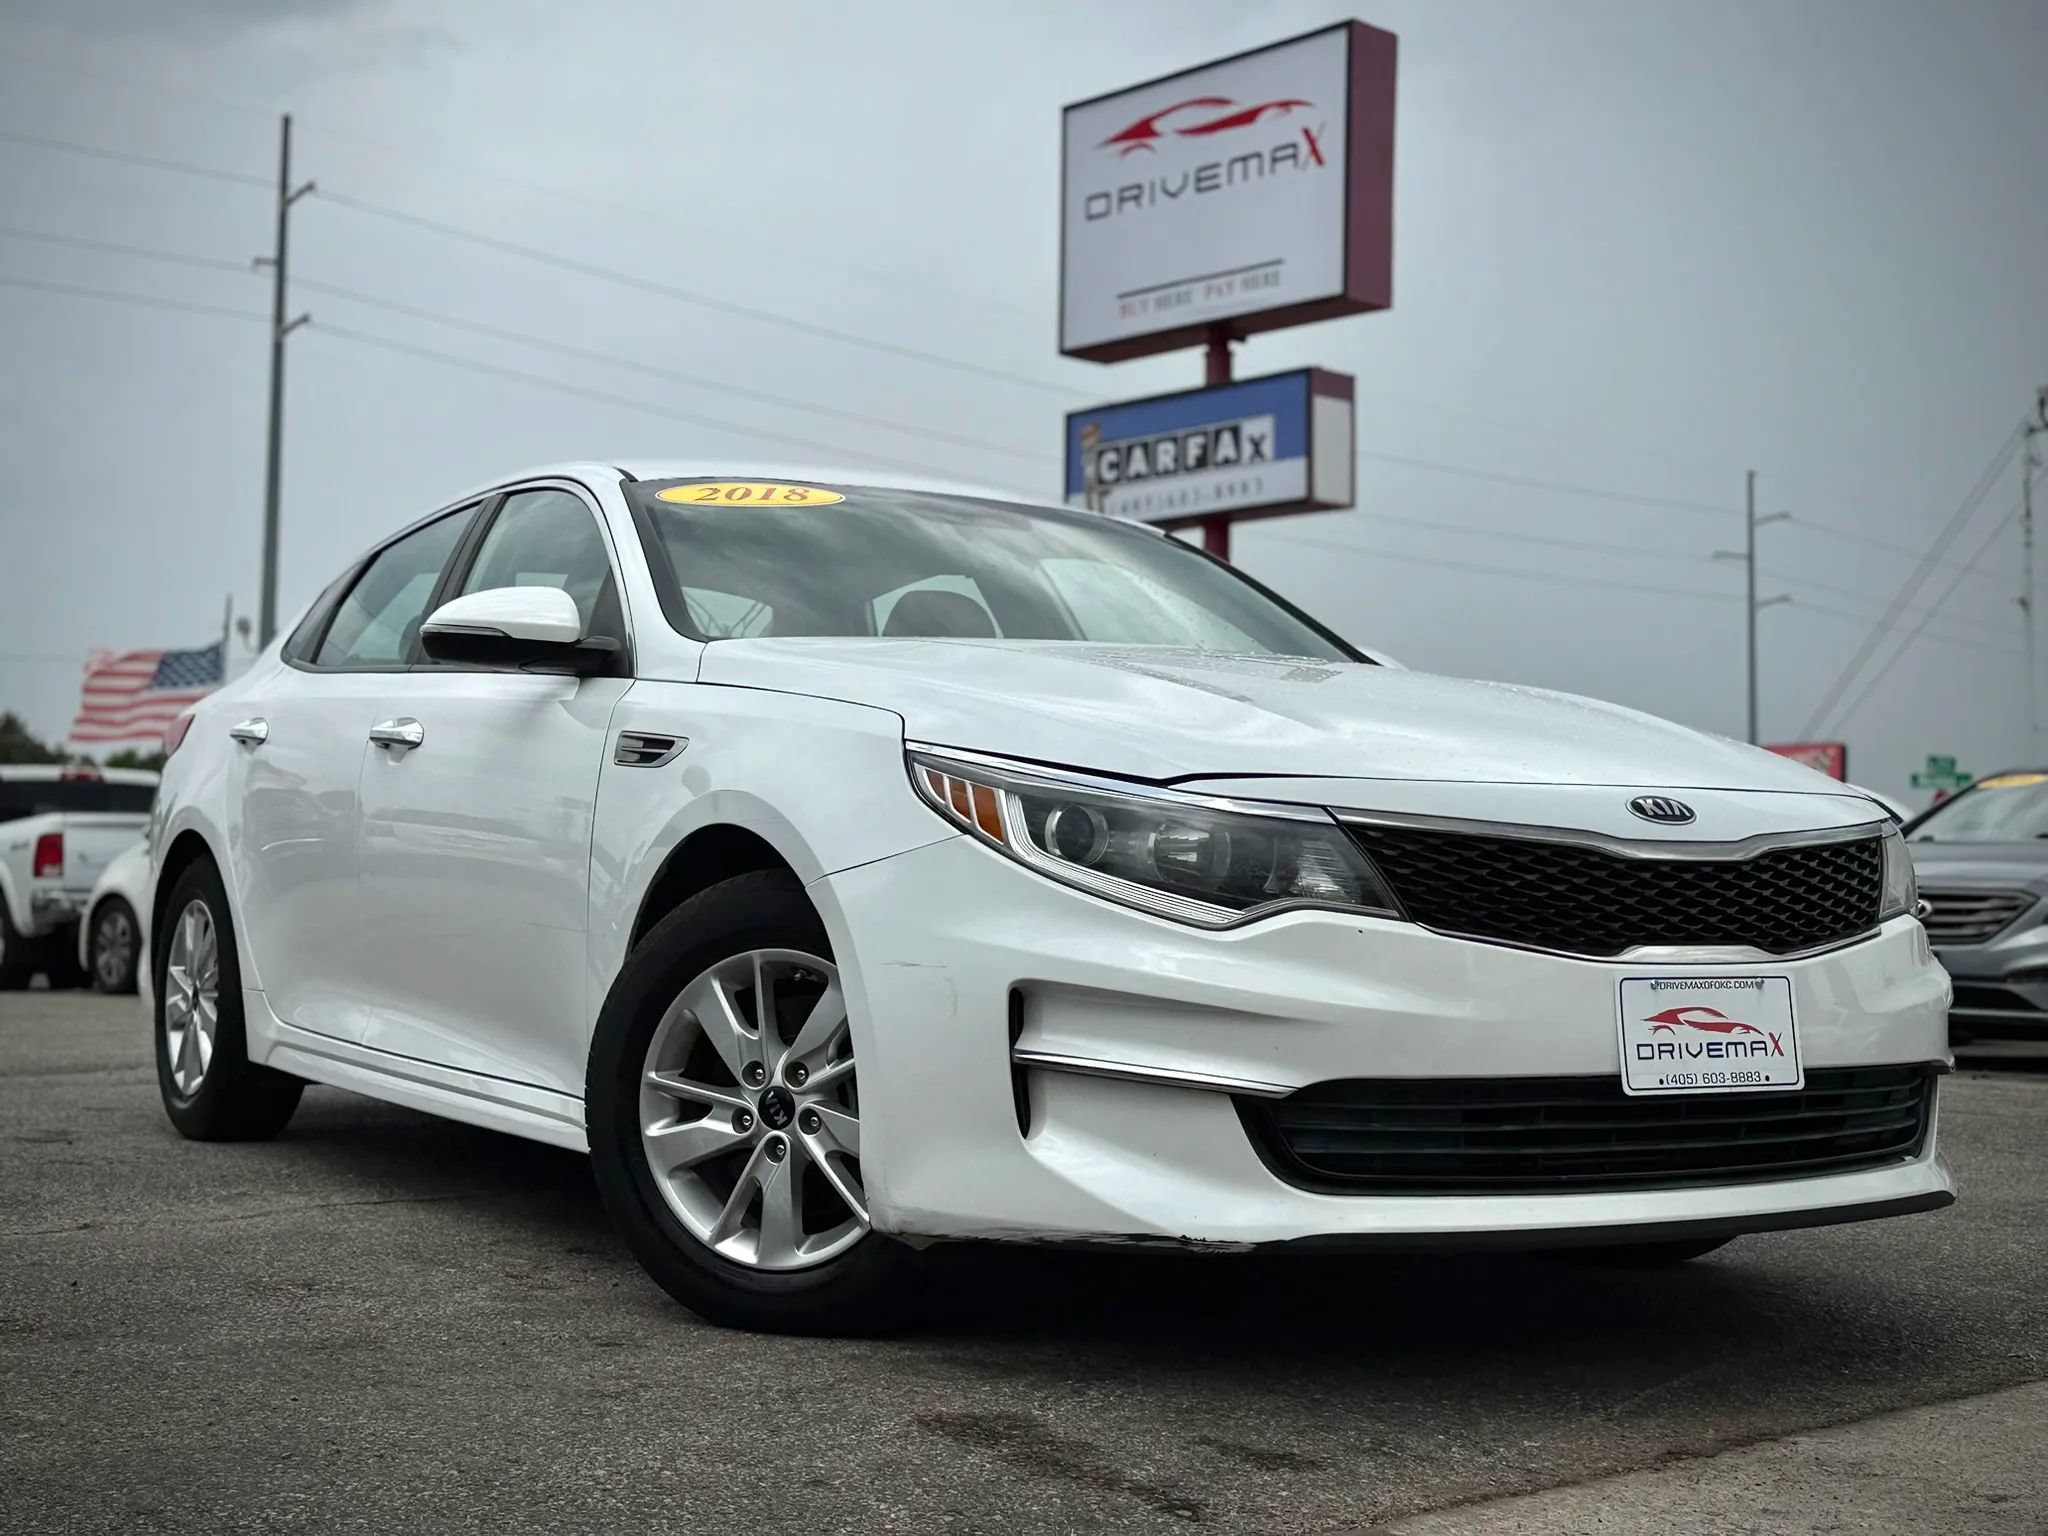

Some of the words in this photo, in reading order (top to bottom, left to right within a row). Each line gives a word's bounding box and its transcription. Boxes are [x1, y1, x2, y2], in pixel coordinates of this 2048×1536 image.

[1084, 122, 1327, 222] DRIVEMAX
[1098, 426, 1266, 483] CARFAX
[694, 487, 810, 501] 2018
[1635, 797, 1691, 817] KIA
[1659, 980, 1754, 990] DRIVEMAXOFOKC.COM
[1636, 1031, 1785, 1061] DRIVEMAX
[1665, 1073, 1698, 1086] (405)
[1702, 1071, 1762, 1084] 603-8883
